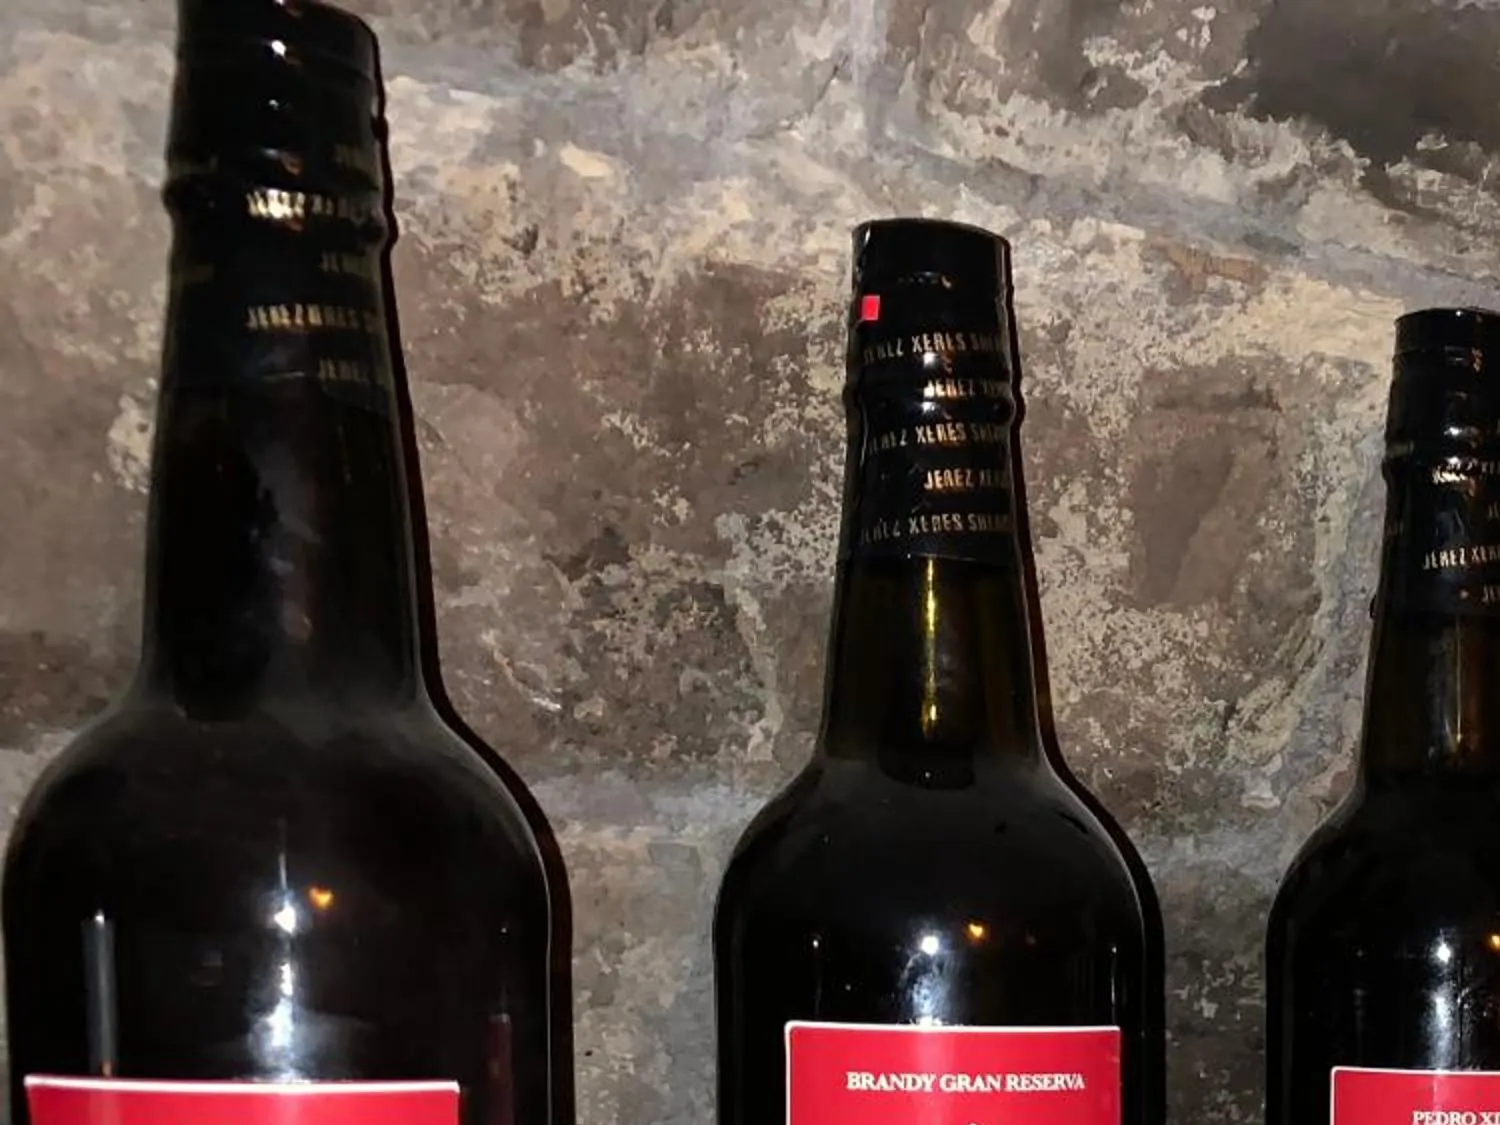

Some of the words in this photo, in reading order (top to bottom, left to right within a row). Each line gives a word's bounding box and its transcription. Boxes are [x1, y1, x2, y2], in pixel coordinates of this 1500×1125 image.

[923, 468, 974, 490] JEREZ
[1423, 548, 1467, 570] JEREZ
[847, 1072, 937, 1092] BRANDY
[939, 1074, 1001, 1092] GRAN
[1005, 1074, 1084, 1092] RESERVA
